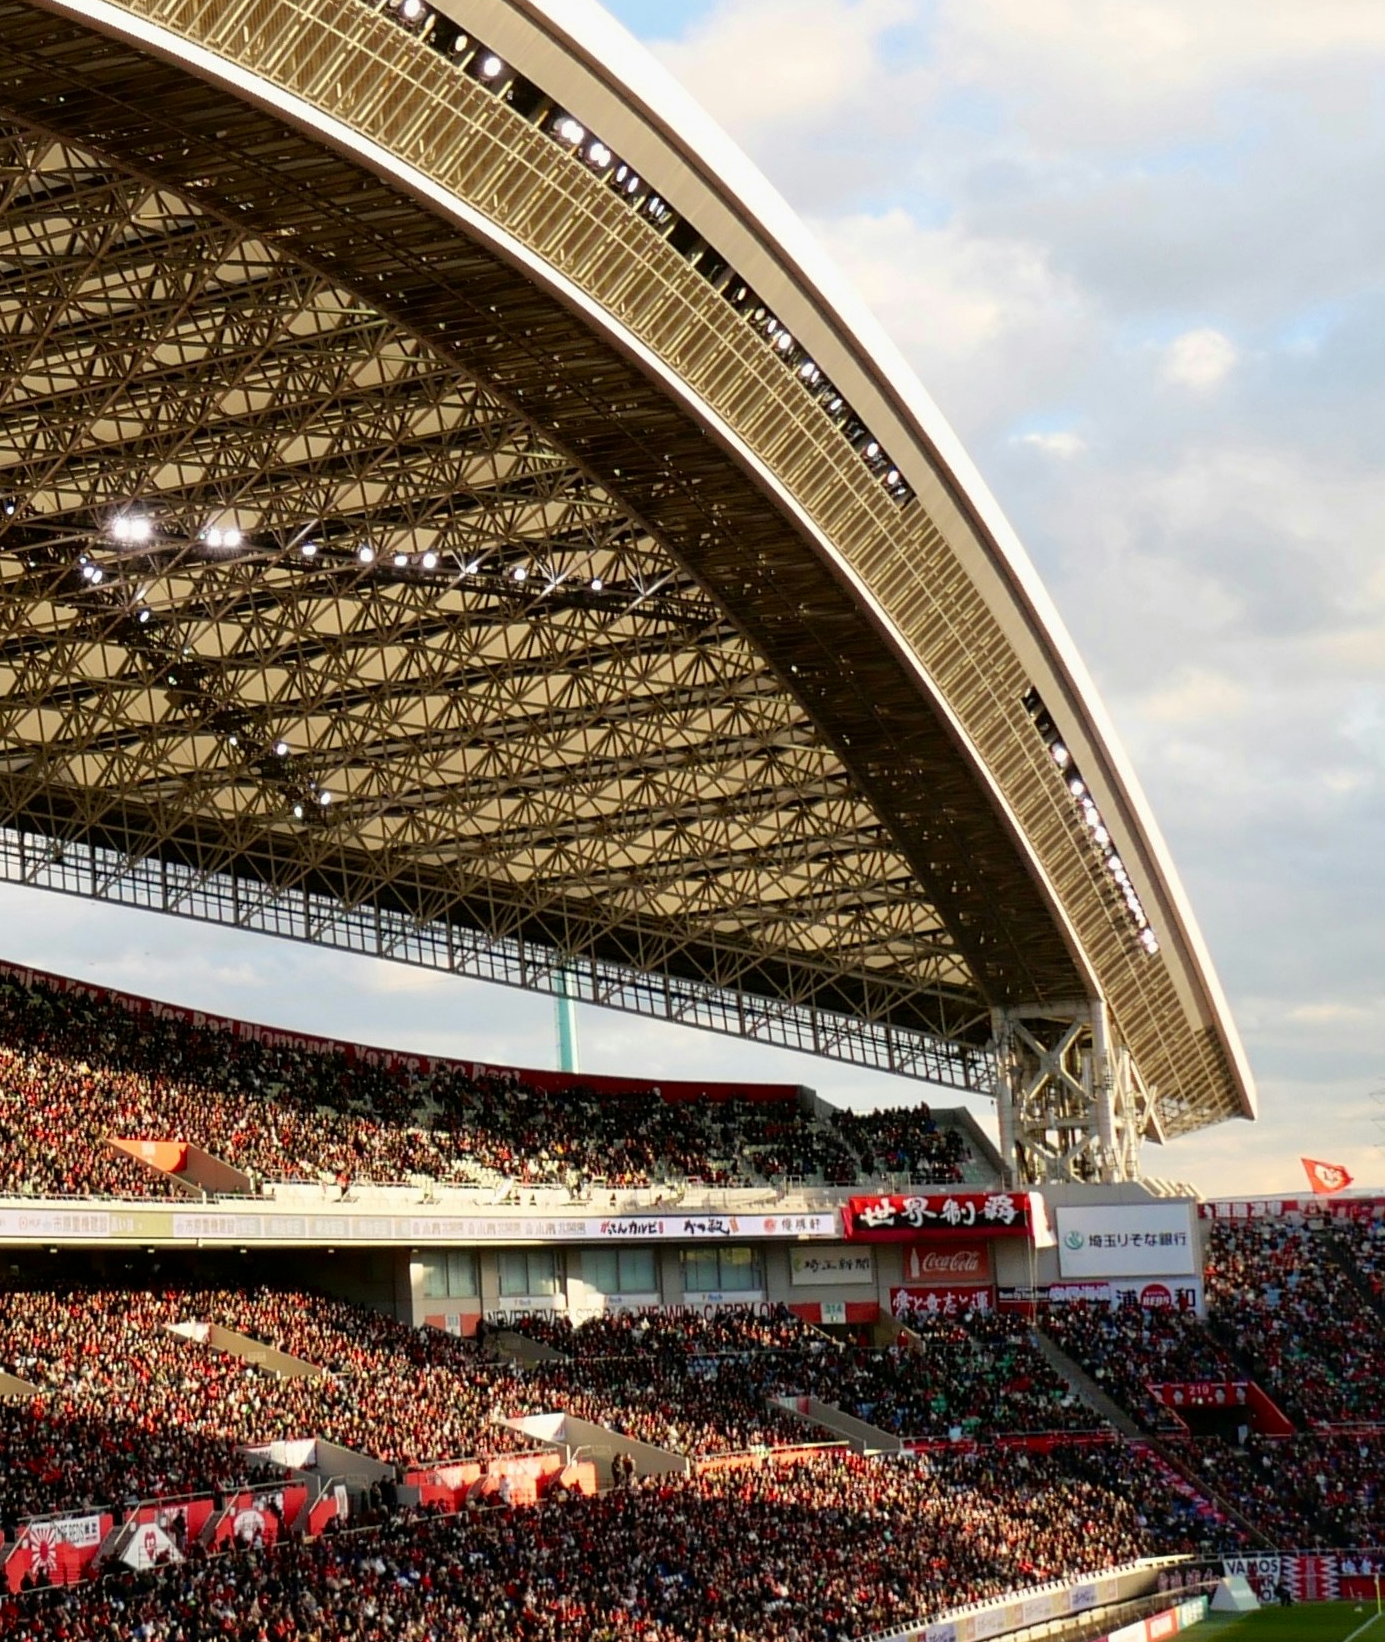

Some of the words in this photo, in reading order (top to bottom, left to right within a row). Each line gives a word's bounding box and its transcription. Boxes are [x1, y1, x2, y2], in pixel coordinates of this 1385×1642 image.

[1089, 1231, 1187, 1249] 埼玉りそな銀行
[1227, 1560, 1279, 1574] VAMOS
